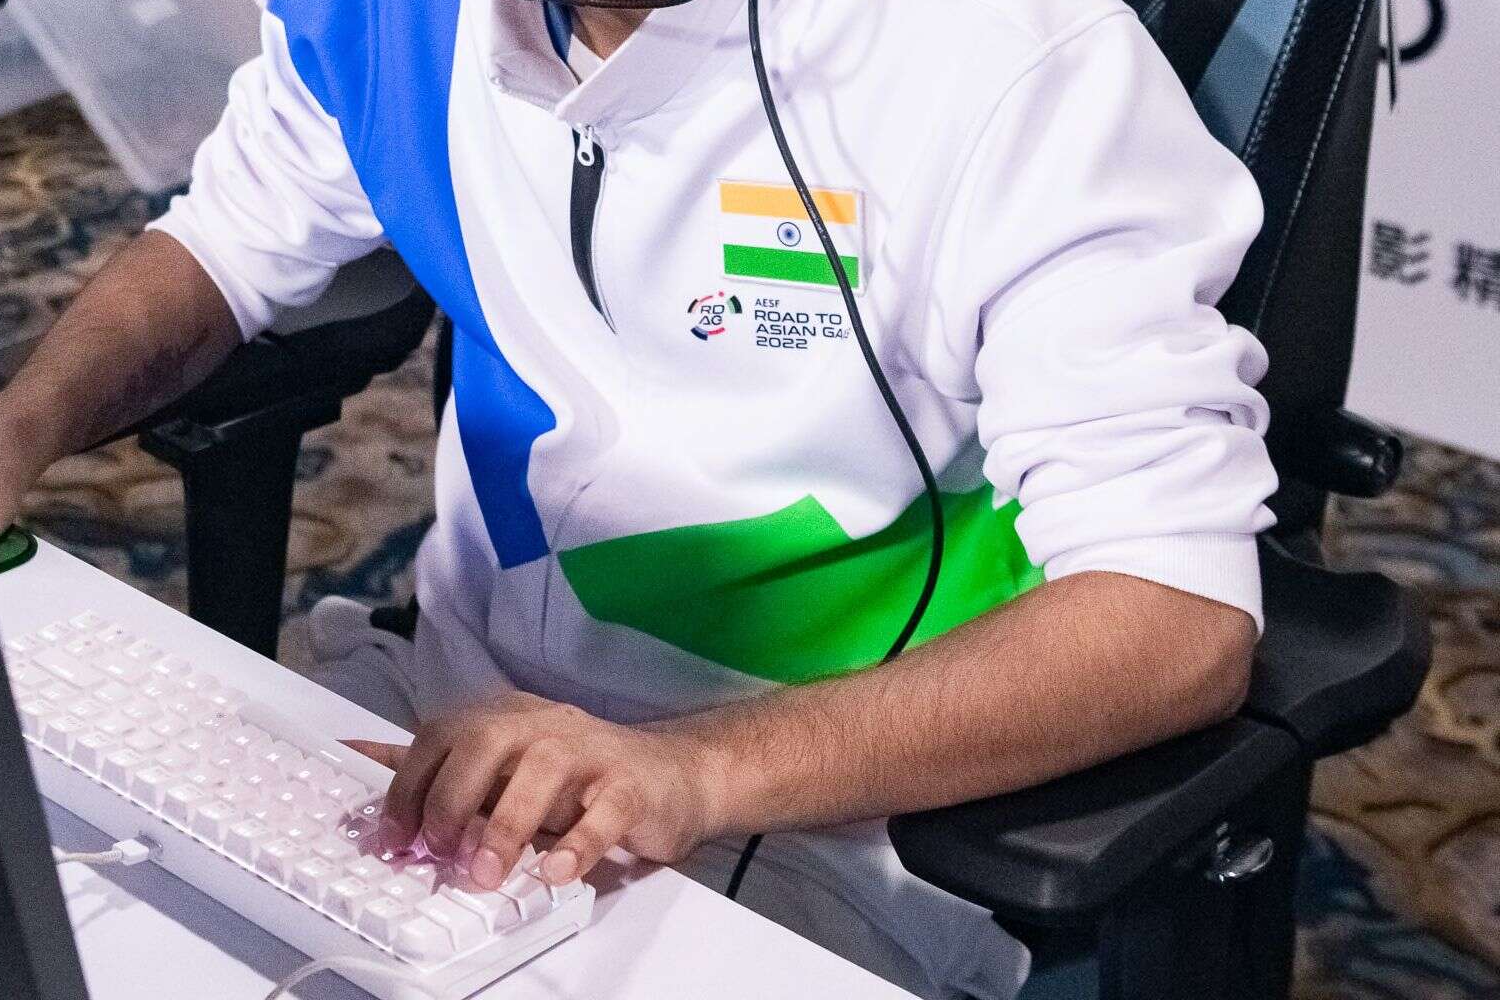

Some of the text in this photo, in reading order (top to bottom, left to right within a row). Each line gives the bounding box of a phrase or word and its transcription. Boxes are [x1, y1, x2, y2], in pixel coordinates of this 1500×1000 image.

[755, 297, 781, 308] AESF
[754, 309, 842, 325] ROAD TO
[756, 323, 817, 337] ASIAN
[756, 335, 809, 350] 2022
